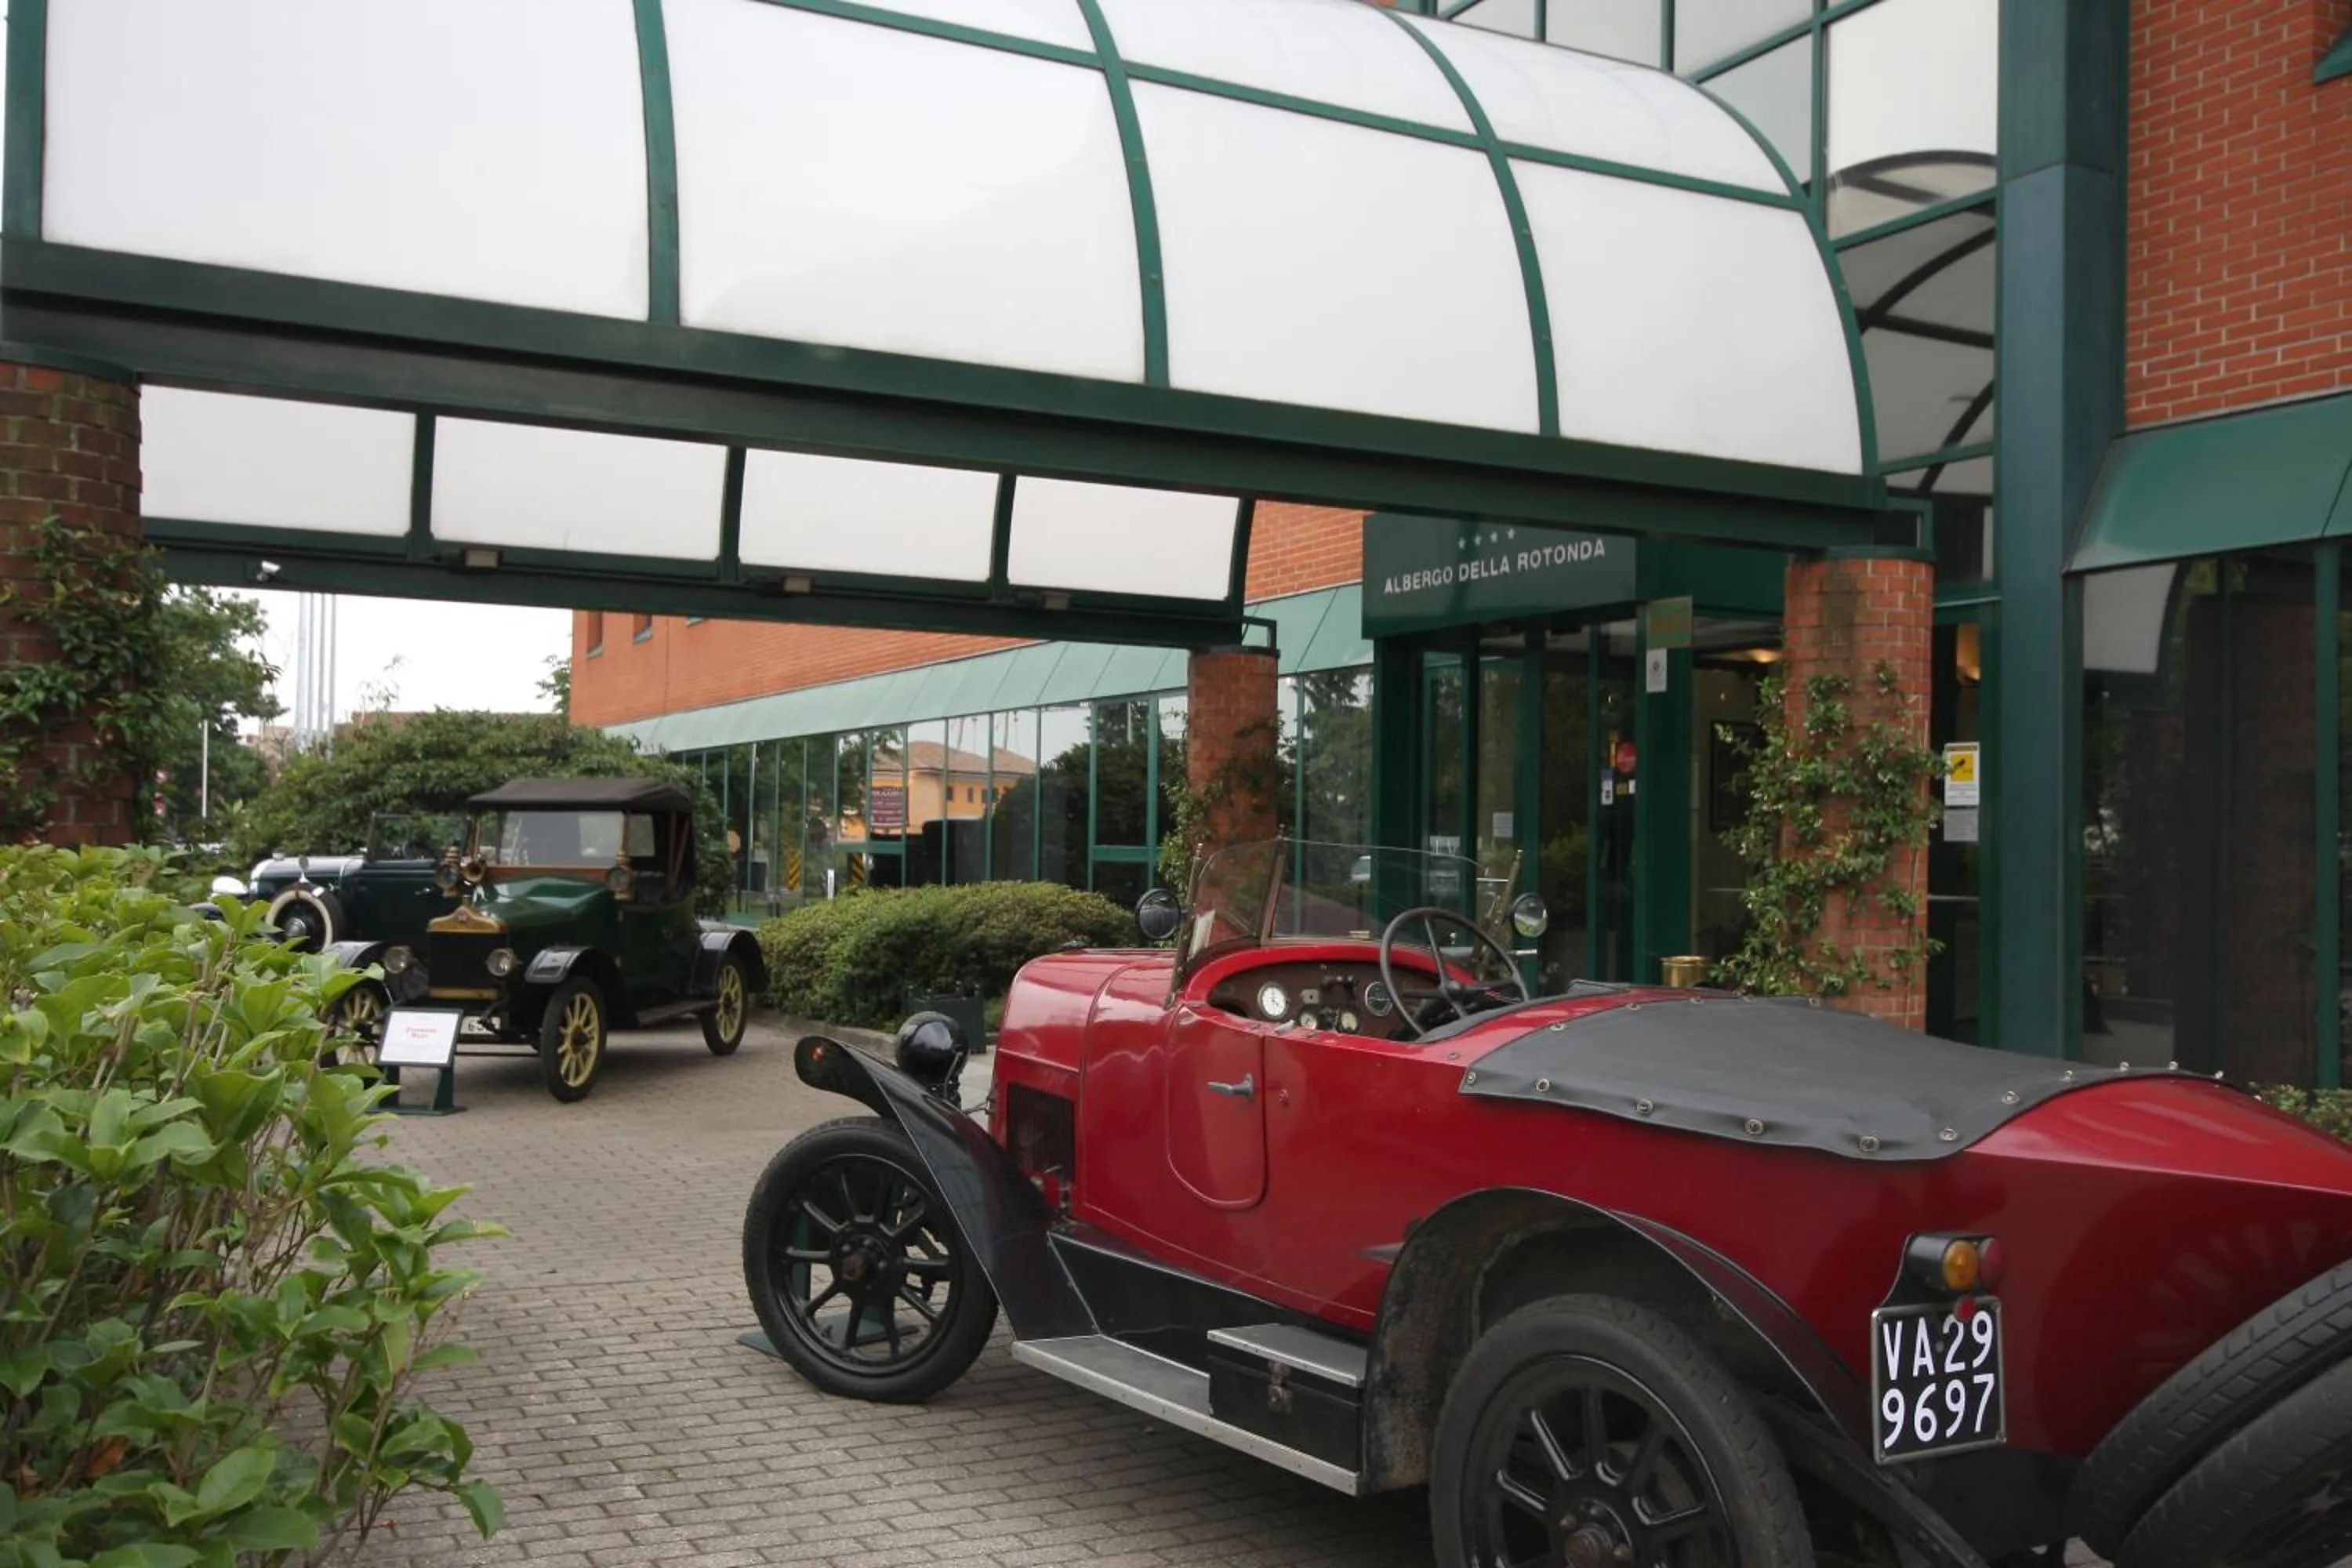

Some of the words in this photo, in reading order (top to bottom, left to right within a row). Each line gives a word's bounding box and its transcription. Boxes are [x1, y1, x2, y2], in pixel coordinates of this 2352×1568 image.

[1383, 566, 1453, 595] ALBERGO
[1459, 554, 1511, 582] DELLA
[1517, 539, 1606, 572] ROTONDA
[1882, 1373, 1995, 1450] 9697
